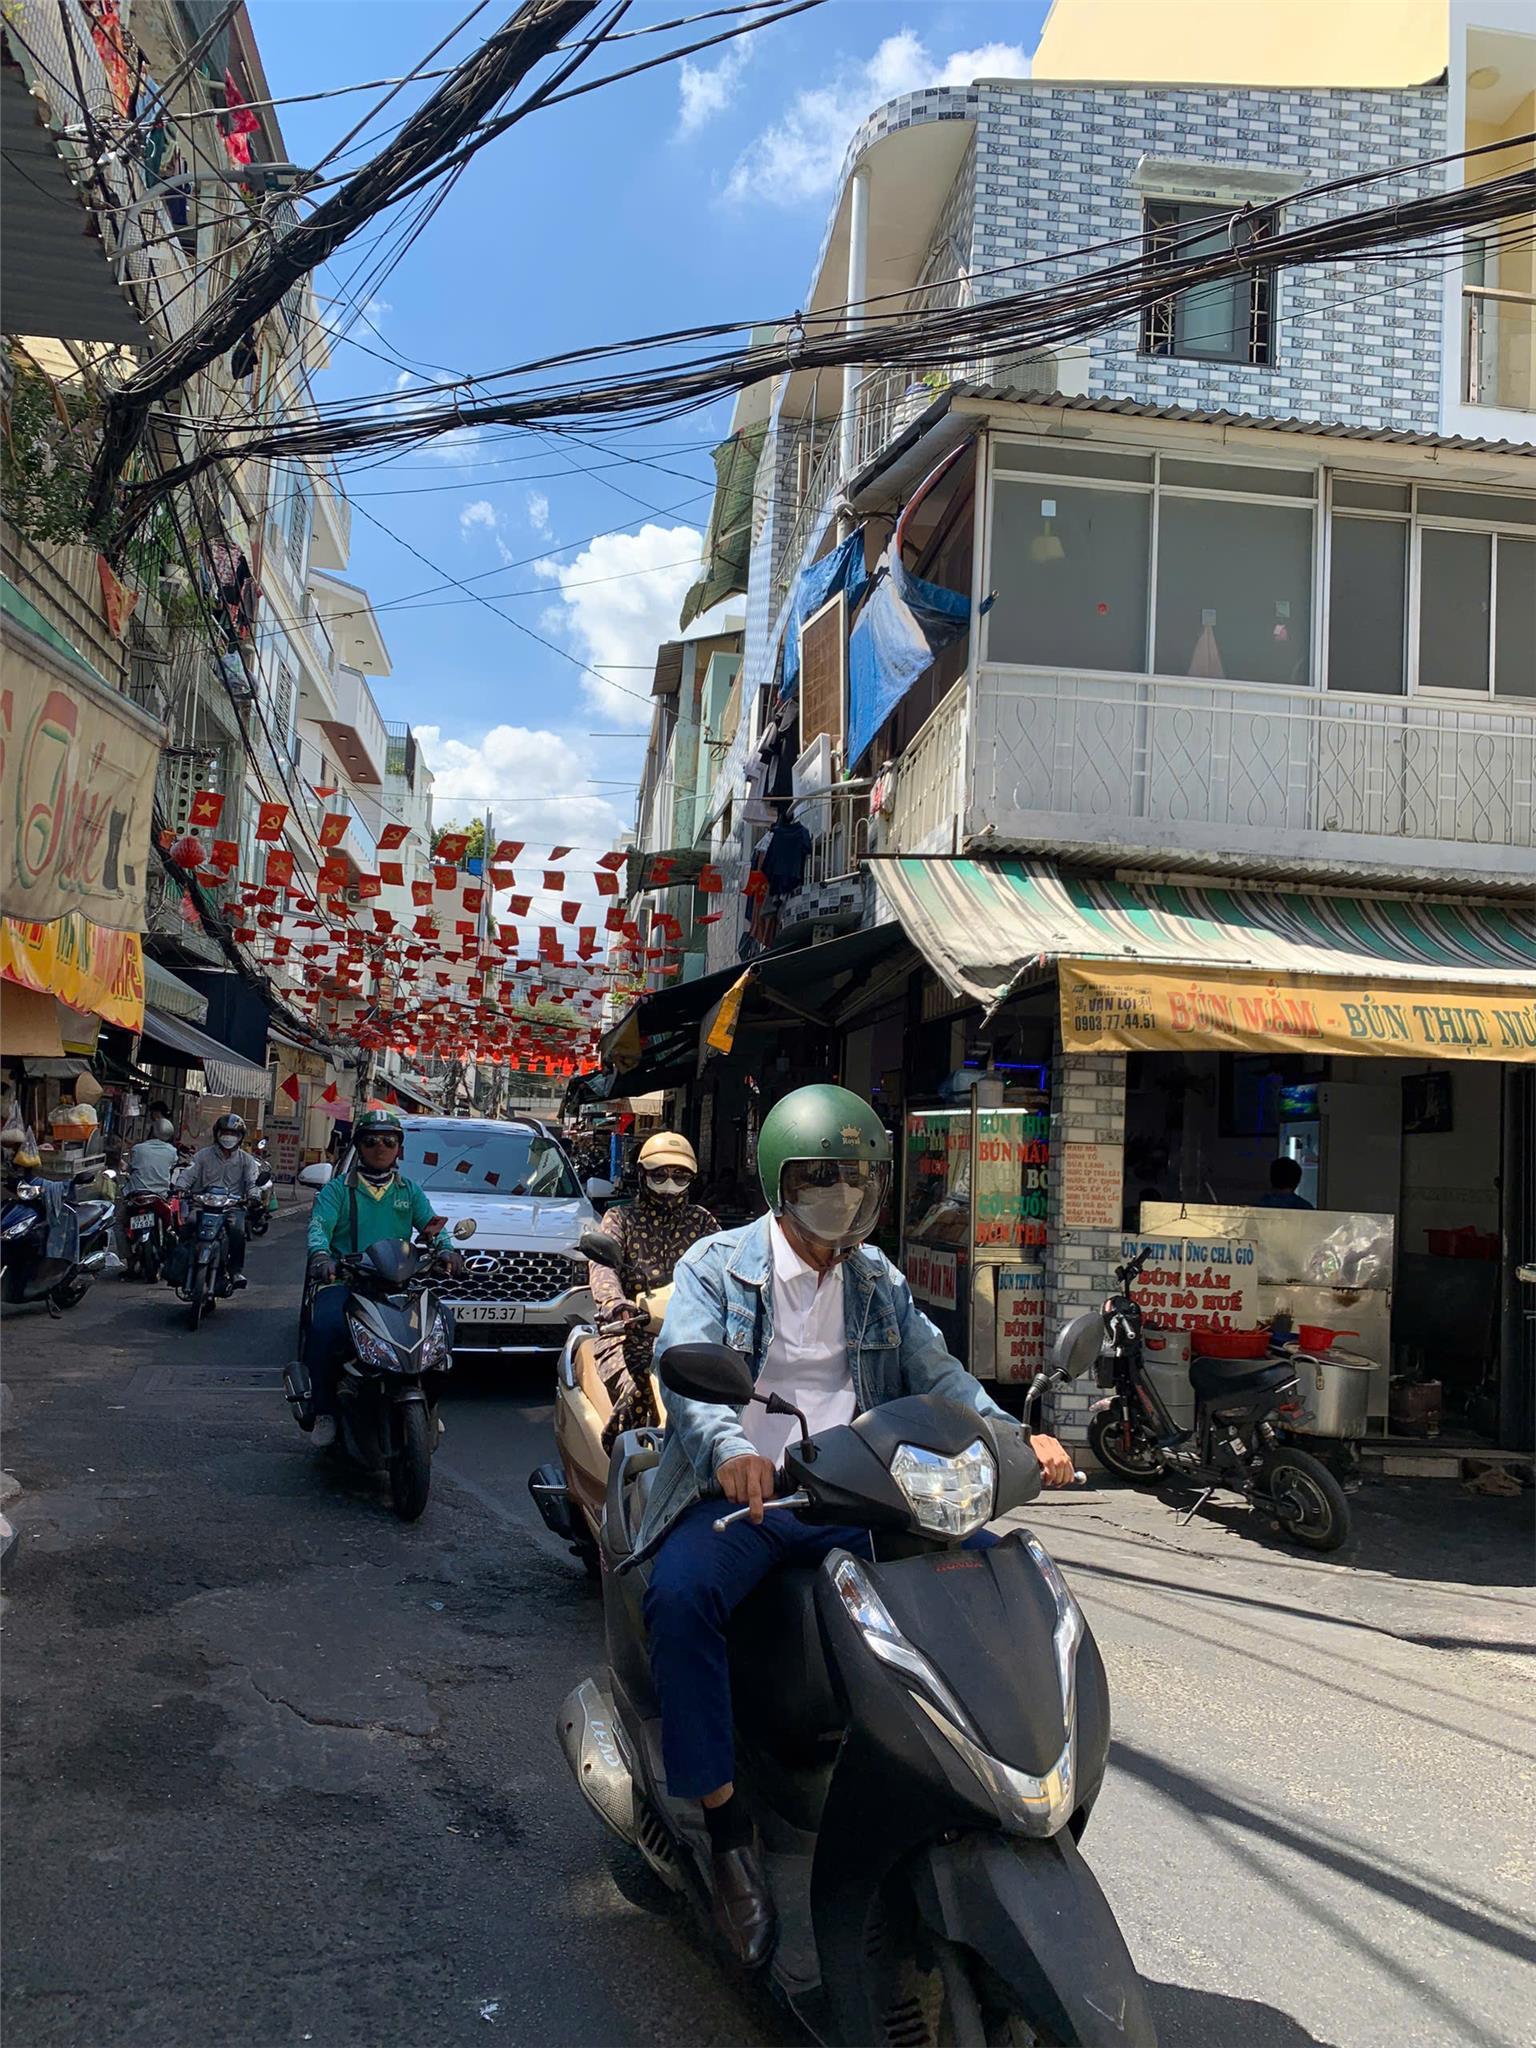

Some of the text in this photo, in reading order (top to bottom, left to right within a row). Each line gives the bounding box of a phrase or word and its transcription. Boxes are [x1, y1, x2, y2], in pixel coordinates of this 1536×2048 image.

[1075, 1014, 1156, 1031] 0903.77.44.51
[1167, 982, 1237, 1034] BÚN
[1340, 992, 1413, 1042] BÚN
[1413, 1005, 1491, 1056] THỊT
[978, 1139, 1012, 1162] BÚN
[1121, 1236, 1138, 1259] ÚN
[1235, 1243, 1254, 1266] GIÒ
[1137, 1267, 1181, 1288] BÚN
[1012, 1297, 1038, 1316] BÚN
[1171, 1290, 1198, 1309] BÒ
[1202, 1289, 1244, 1312] HUẾ
[450, 1307, 517, 1321] 1K-175.37
[1004, 1318, 1030, 1337] BÚN
[1010, 1338, 1036, 1357] BÚN
[590, 1720, 621, 1767] LEAD
